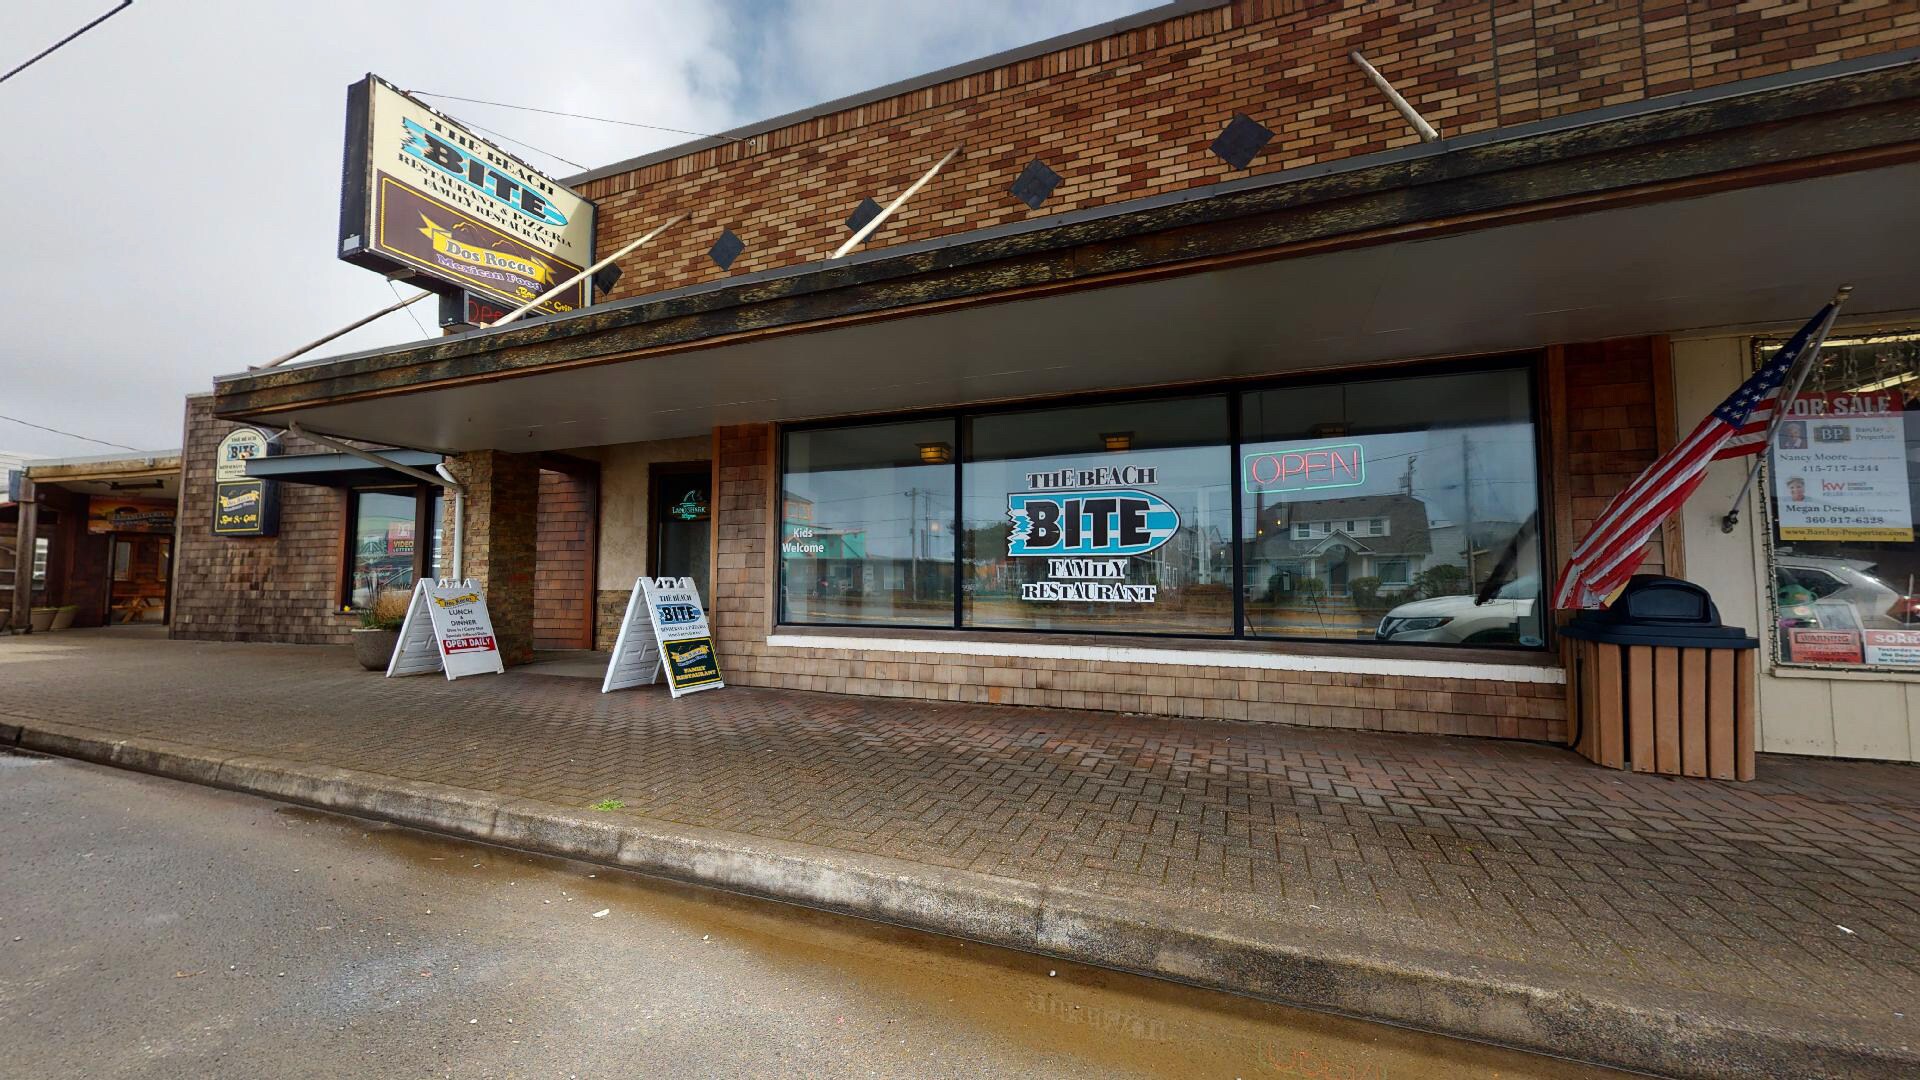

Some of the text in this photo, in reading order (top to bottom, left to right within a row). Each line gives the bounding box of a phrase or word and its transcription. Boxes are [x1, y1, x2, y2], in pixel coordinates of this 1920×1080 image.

[430, 118, 554, 196] THE BEACH
[424, 133, 547, 220] BITE
[399, 153, 497, 209] RESTAURANT
[513, 212, 572, 248] PIZZERIA
[424, 178, 556, 248] FAMILY RESTAURANT
[445, 239, 536, 276] Dos Rocas
[436, 254, 543, 293] Mexican Food
[1833, 396, 1890, 415] SALE
[1822, 428, 1845, 440] BP
[1252, 448, 1359, 485] OPEN
[1779, 453, 1811, 462] Nancy
[1814, 453, 1848, 461] Moore
[1027, 465, 1158, 489] THE BEACH
[1786, 504, 1865, 514] Megan Despain
[793, 527, 813, 538] Kids
[1024, 498, 1151, 548] BITE
[393, 540, 414, 548] VIDEO
[782, 543, 825, 553] Welcome
[1048, 559, 1127, 578] FAMILY
[1022, 582, 1156, 602] RESTAURANT
[448, 608, 473, 616] LUNCH
[662, 606, 696, 621] BITE
[446, 637, 491, 648] OPEN DAILY
